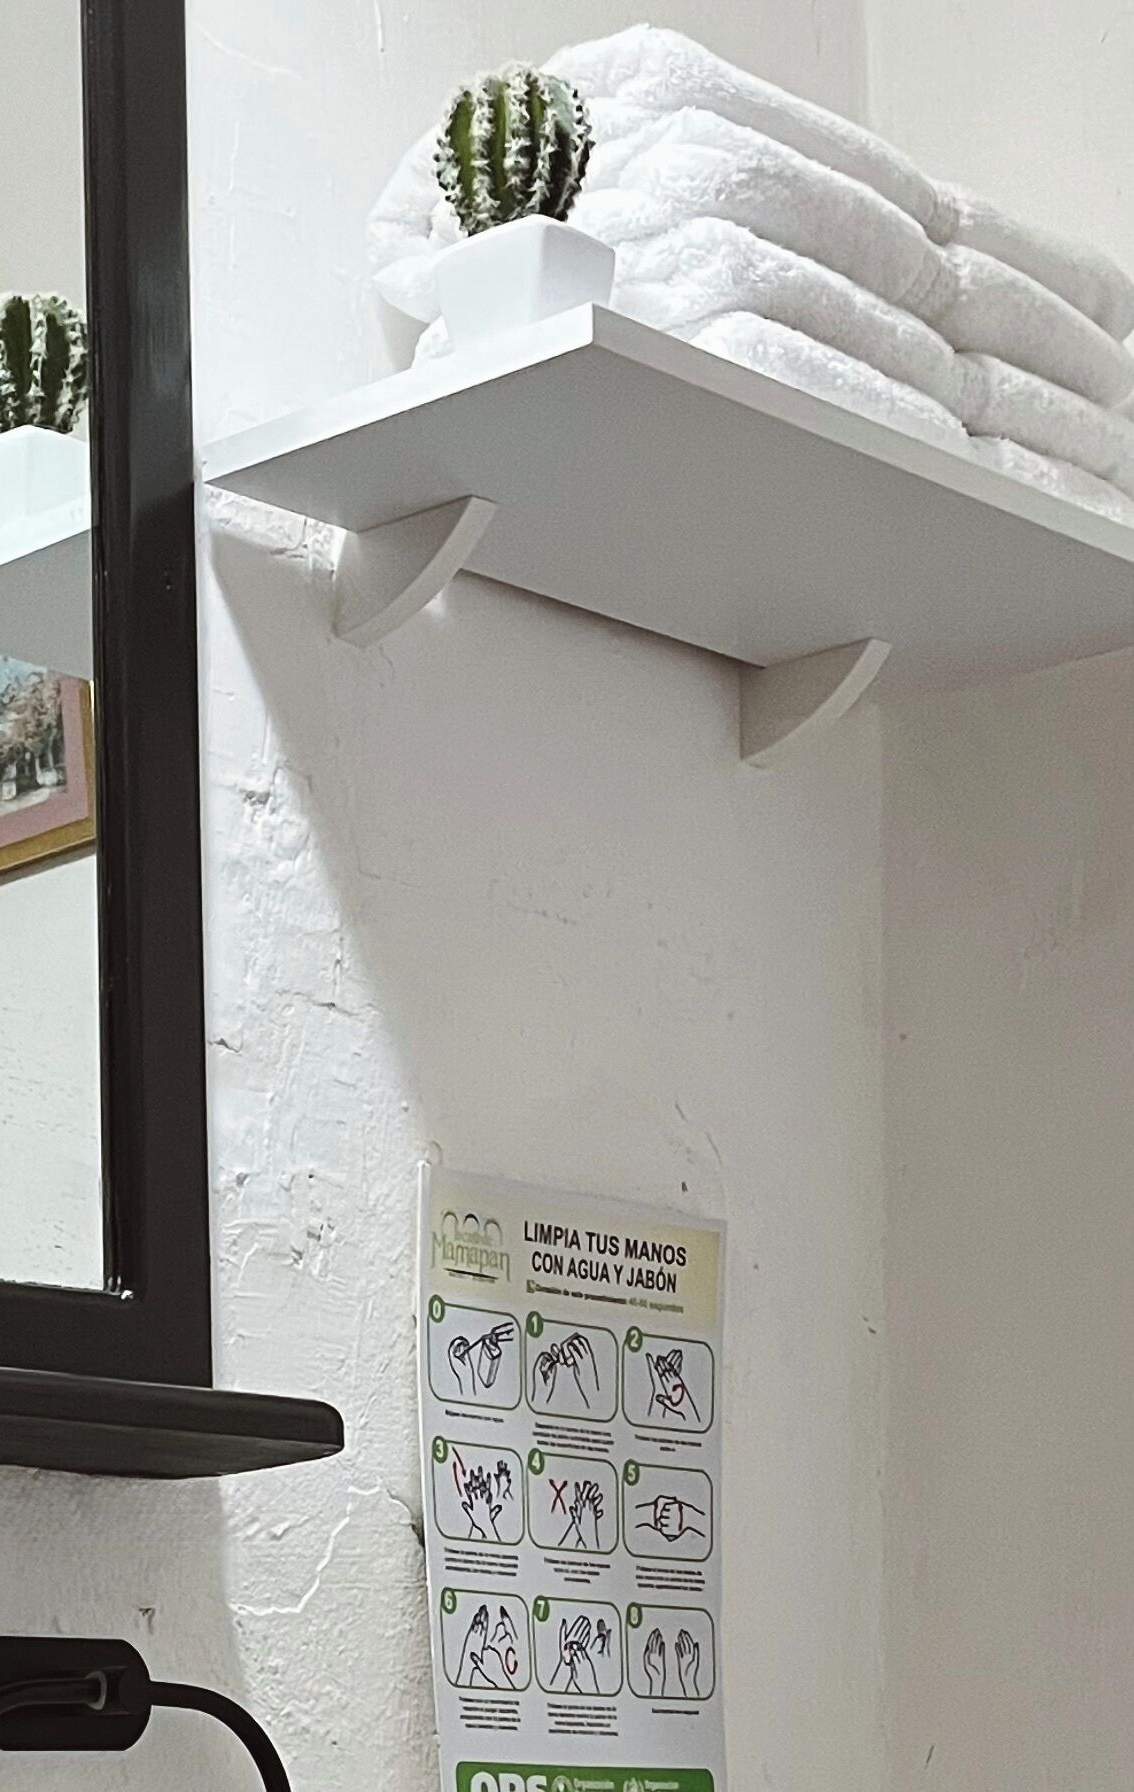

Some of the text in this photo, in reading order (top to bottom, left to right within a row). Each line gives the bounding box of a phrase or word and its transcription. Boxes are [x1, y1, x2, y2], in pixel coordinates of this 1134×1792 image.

[524, 1220, 582, 1251] LIMPIA
[586, 1231, 620, 1256] TUS
[625, 1238, 687, 1267] MANOS
[531, 1250, 677, 1293] CON AGUA Y JABÓN
